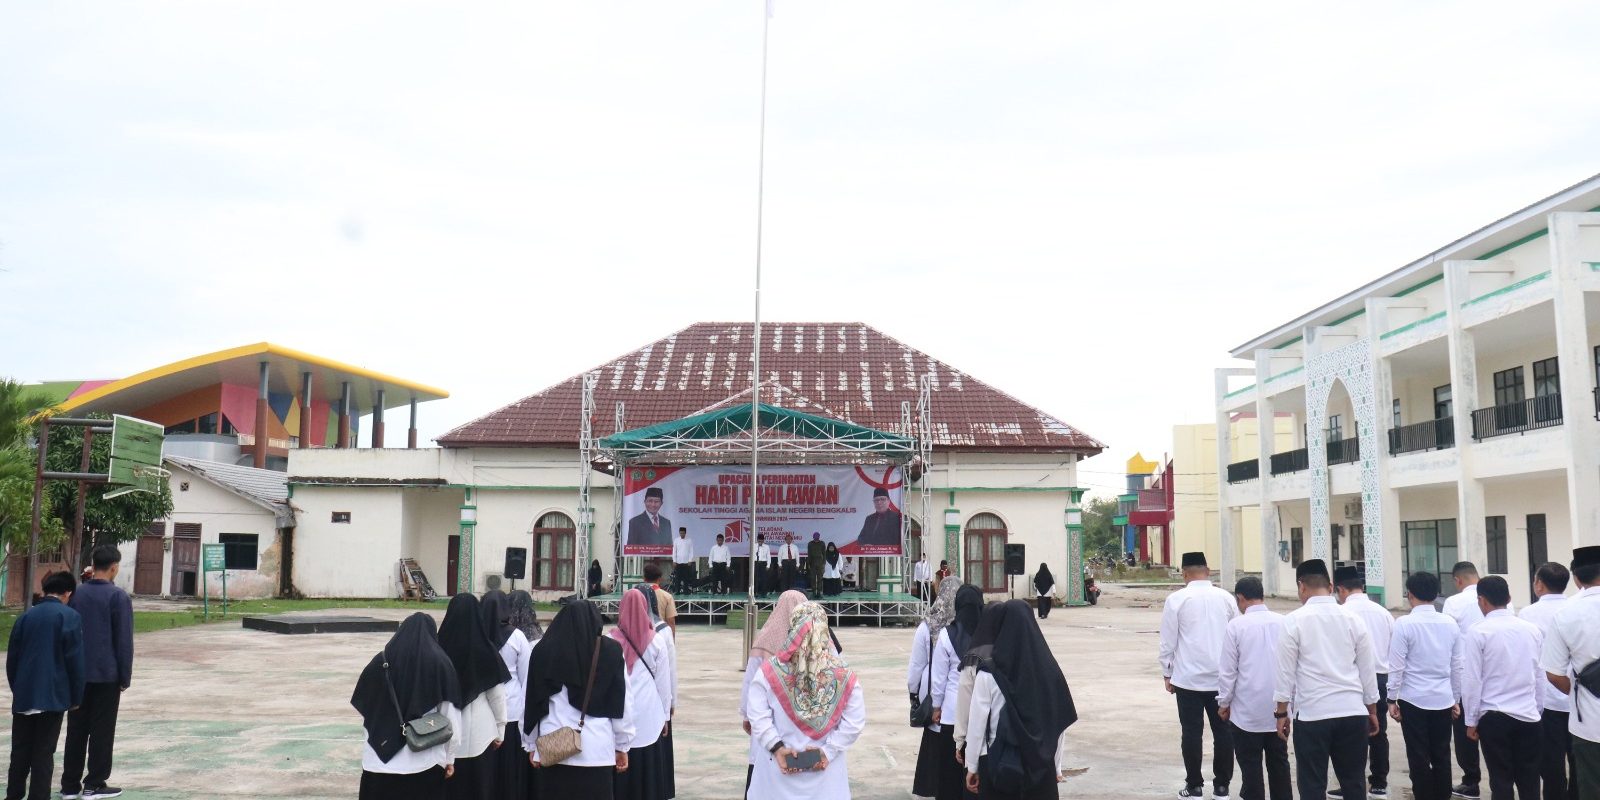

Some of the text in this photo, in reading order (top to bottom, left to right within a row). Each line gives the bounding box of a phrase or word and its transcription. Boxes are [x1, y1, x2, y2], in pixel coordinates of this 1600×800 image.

[761, 474, 816, 485] PERINGATAN
[695, 485, 840, 505] HARI PAHLAWAN
